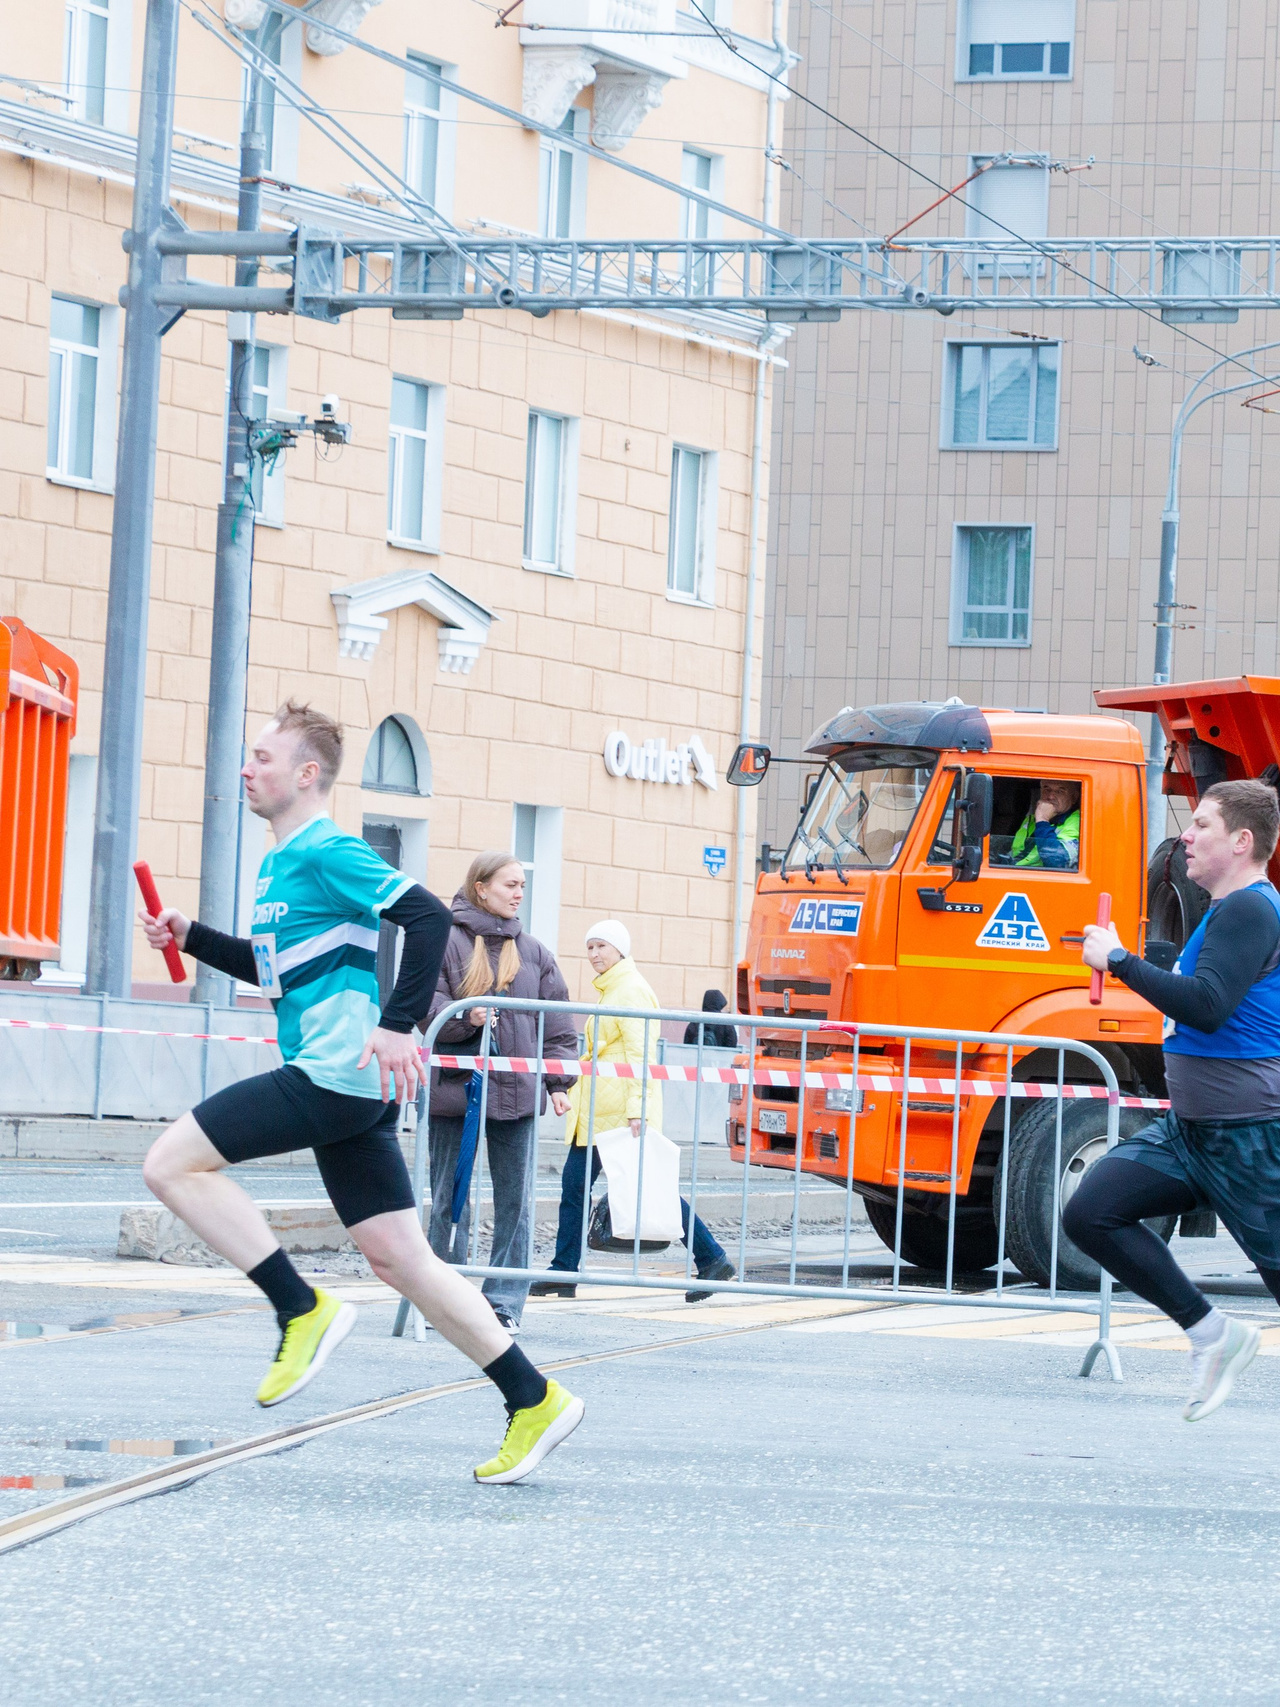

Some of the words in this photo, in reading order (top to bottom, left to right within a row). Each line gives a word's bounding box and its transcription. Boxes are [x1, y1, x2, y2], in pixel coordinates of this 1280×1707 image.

[604, 731, 692, 786] Outlet
[945, 904, 981, 913] 6520
[983, 922, 1045, 941] ДЭС
[981, 939, 1021, 947] ПЕРМСКИЙ
[771, 948, 806, 960] KAMAZ
